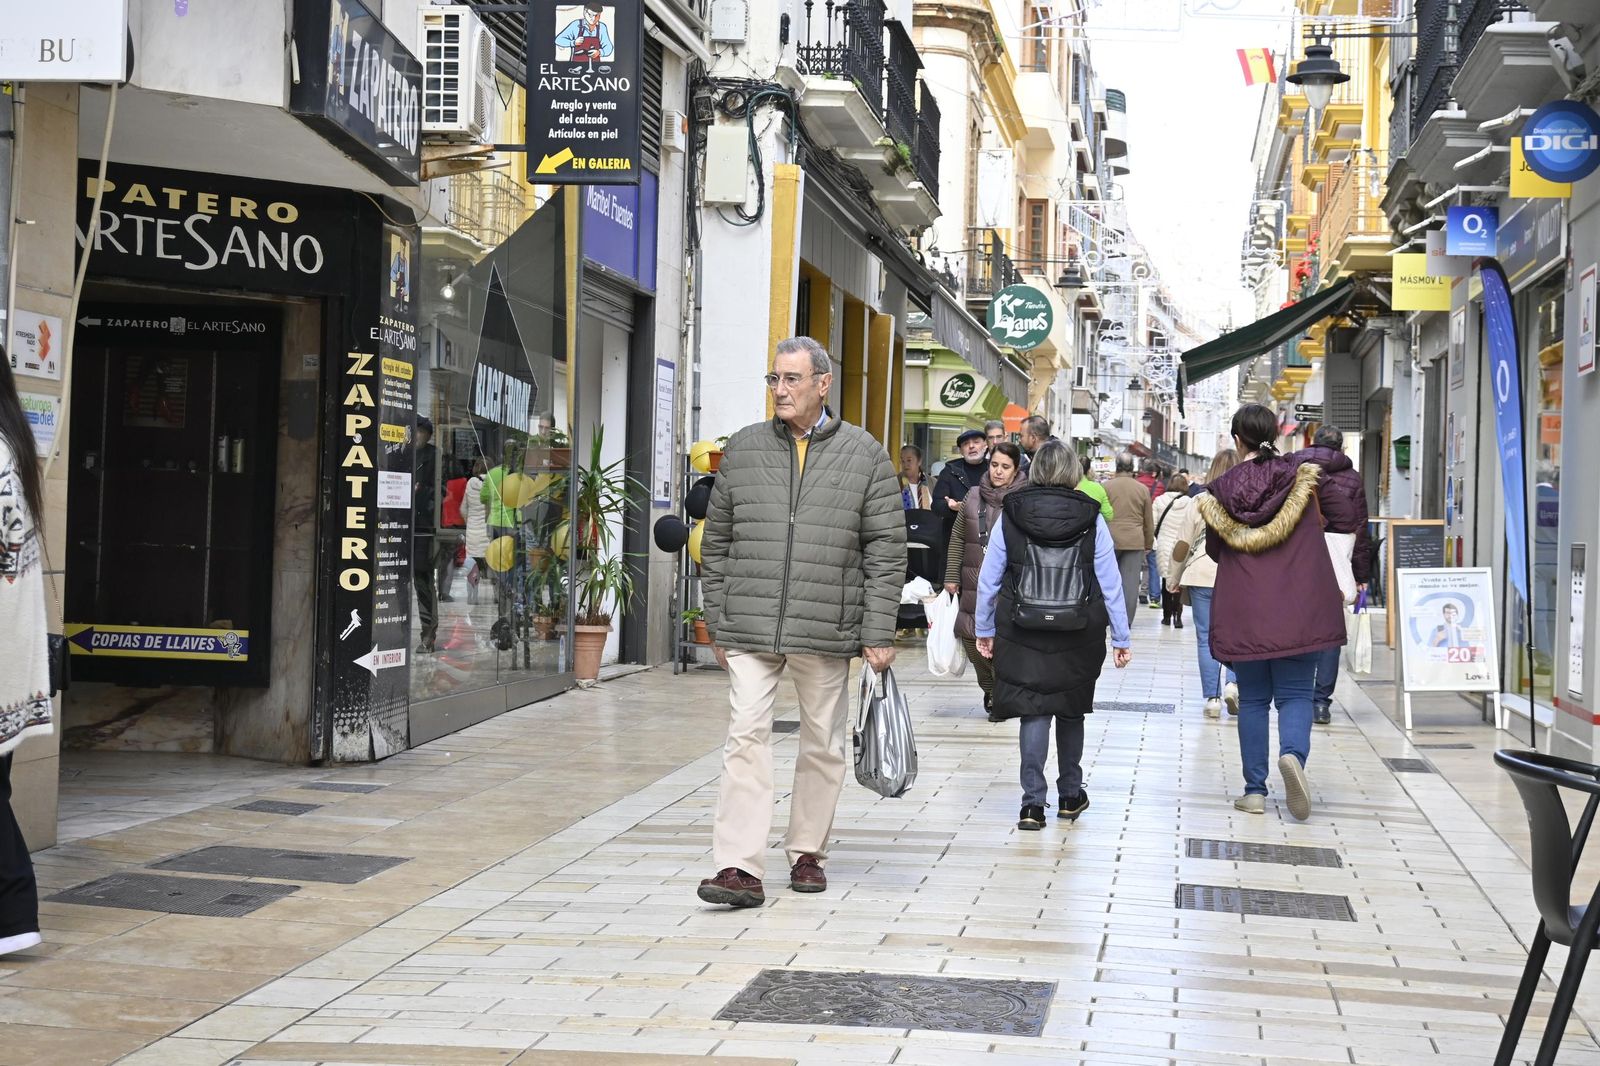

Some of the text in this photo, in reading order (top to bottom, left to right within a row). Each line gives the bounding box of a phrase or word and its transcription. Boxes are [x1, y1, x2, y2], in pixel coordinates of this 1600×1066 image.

[38, 38, 76, 62] BU
[540, 63, 558, 75] EL
[349, 29, 418, 156] ZAPATERO
[538, 74, 631, 94] ARTESANO
[550, 98, 617, 112] Arreglo y venta
[559, 113, 609, 124] del calzado
[548, 128, 619, 141] Artículos en piel
[1524, 134, 1598, 151] DIGI
[572, 157, 632, 170] EN GALERIA
[610, 194, 634, 230] Fuentes
[1399, 275, 1445, 285] MASMOVL
[106, 318, 266, 334] ZAPATERO EL ARTESANO
[379, 315, 415, 333] ZAPATERO
[370, 327, 417, 351] EL ARTESANO
[475, 362, 532, 434] BLACK FRIDAY
[339, 352, 375, 592] ZAPATERO
[91, 633, 215, 651] COPIAS DE LLAVES
[1448, 648, 1471, 662] 20
